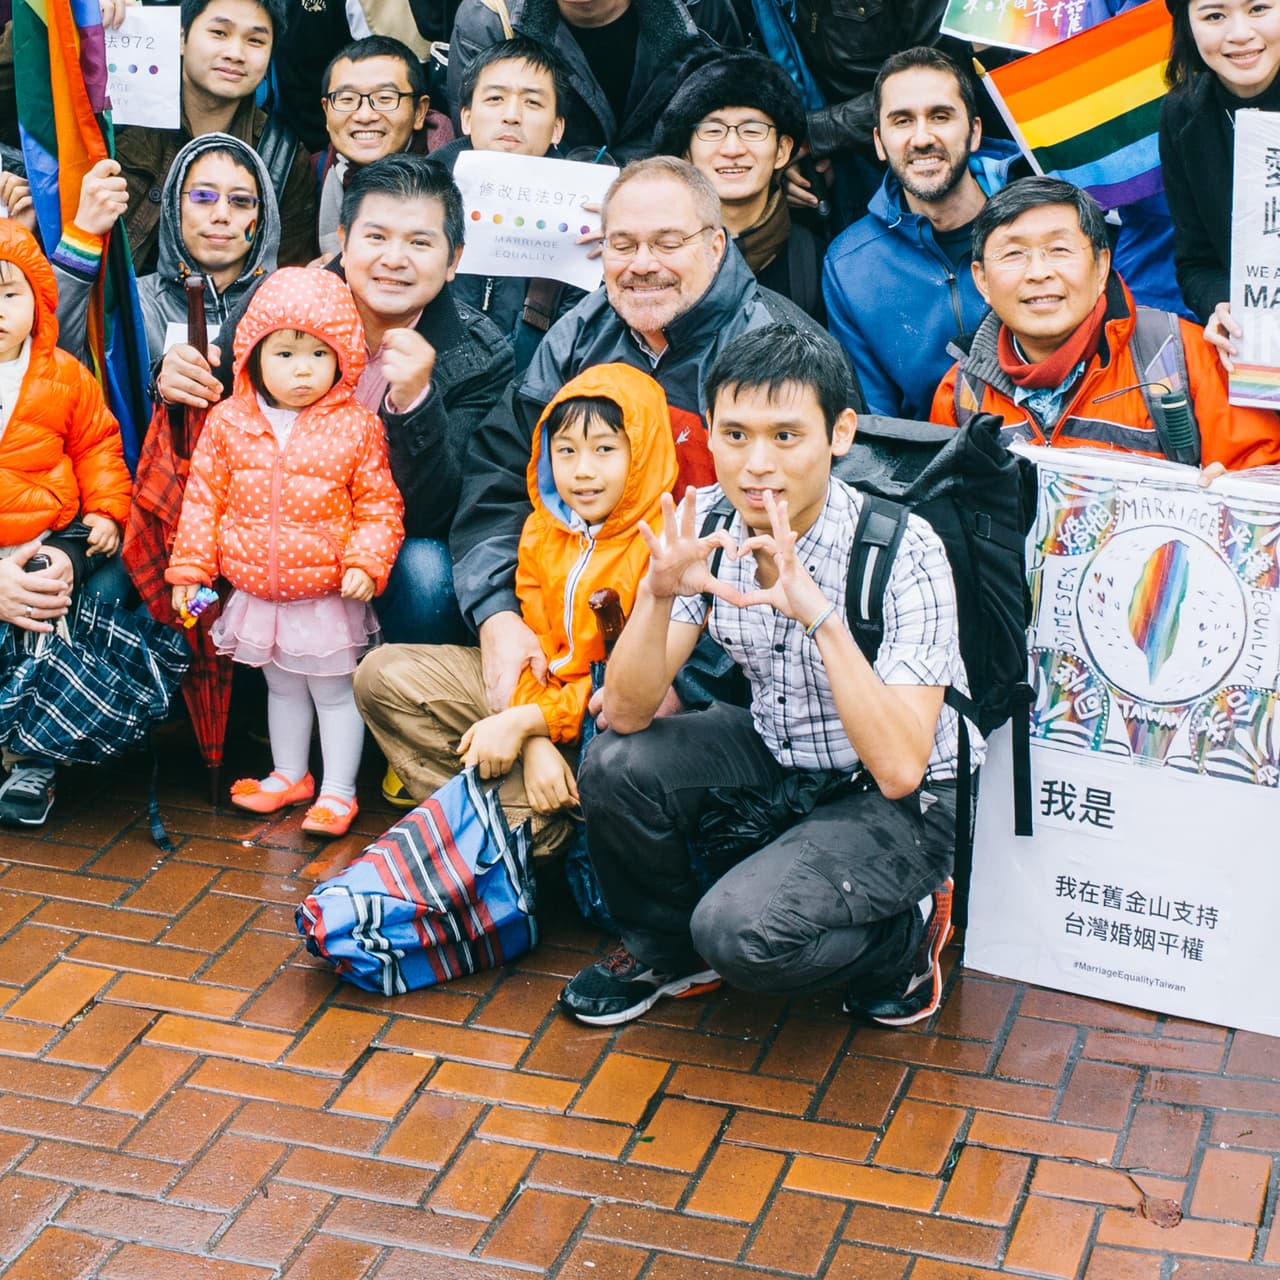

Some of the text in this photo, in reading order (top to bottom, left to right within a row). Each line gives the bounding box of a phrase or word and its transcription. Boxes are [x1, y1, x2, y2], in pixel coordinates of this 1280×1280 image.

[495, 235, 560, 249] MARRIAGE
[495, 250, 555, 262] EQUALITY
[1246, 265, 1270, 279] WE
[1121, 496, 1219, 538] MARRIAGE
[1242, 588, 1273, 684] EQUALITY
[1040, 779, 1116, 830] 我是
[1055, 875, 1220, 931] 我在舊金山支持
[1065, 911, 1206, 963] 台灣婚姻平權
[1074, 960, 1187, 993] #MarriageEqualityTaiwan
